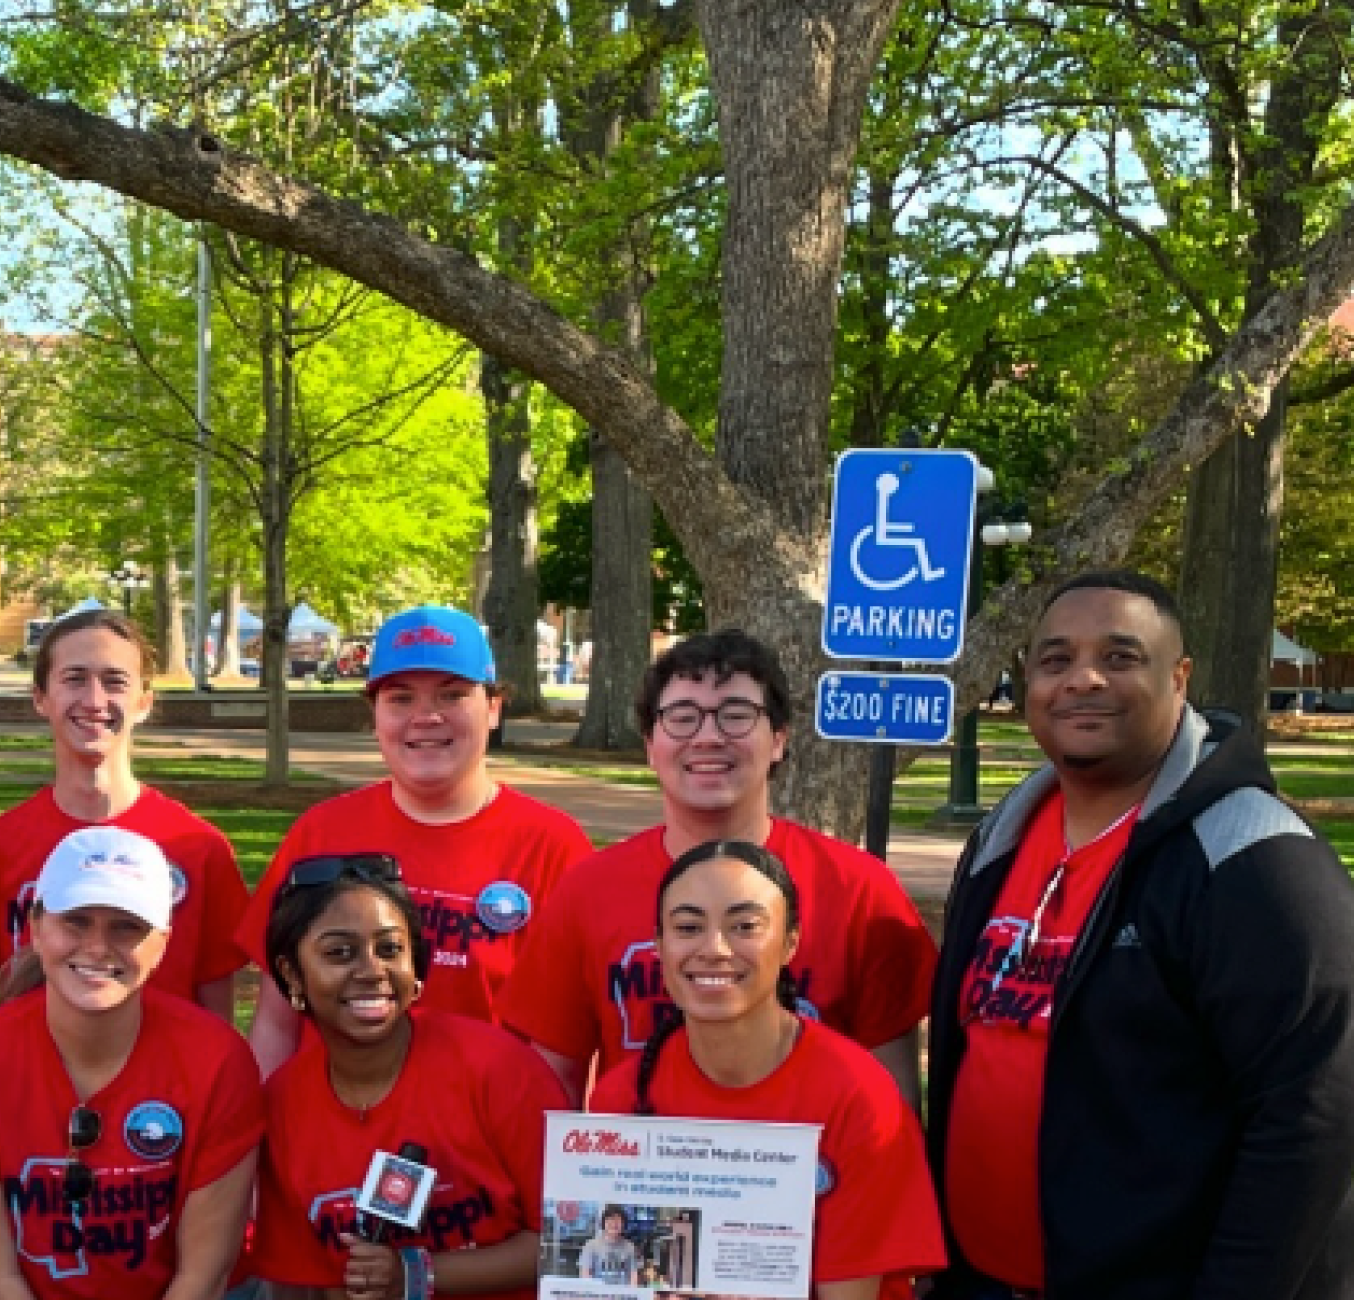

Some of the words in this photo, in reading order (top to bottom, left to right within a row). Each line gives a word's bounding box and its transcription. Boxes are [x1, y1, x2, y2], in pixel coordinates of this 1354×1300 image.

[830, 605, 955, 640] PARKING
[824, 691, 881, 721] $200
[891, 694, 945, 724] FINE
[711, 1147, 751, 1164] Media
[52, 1219, 145, 1271] Day
